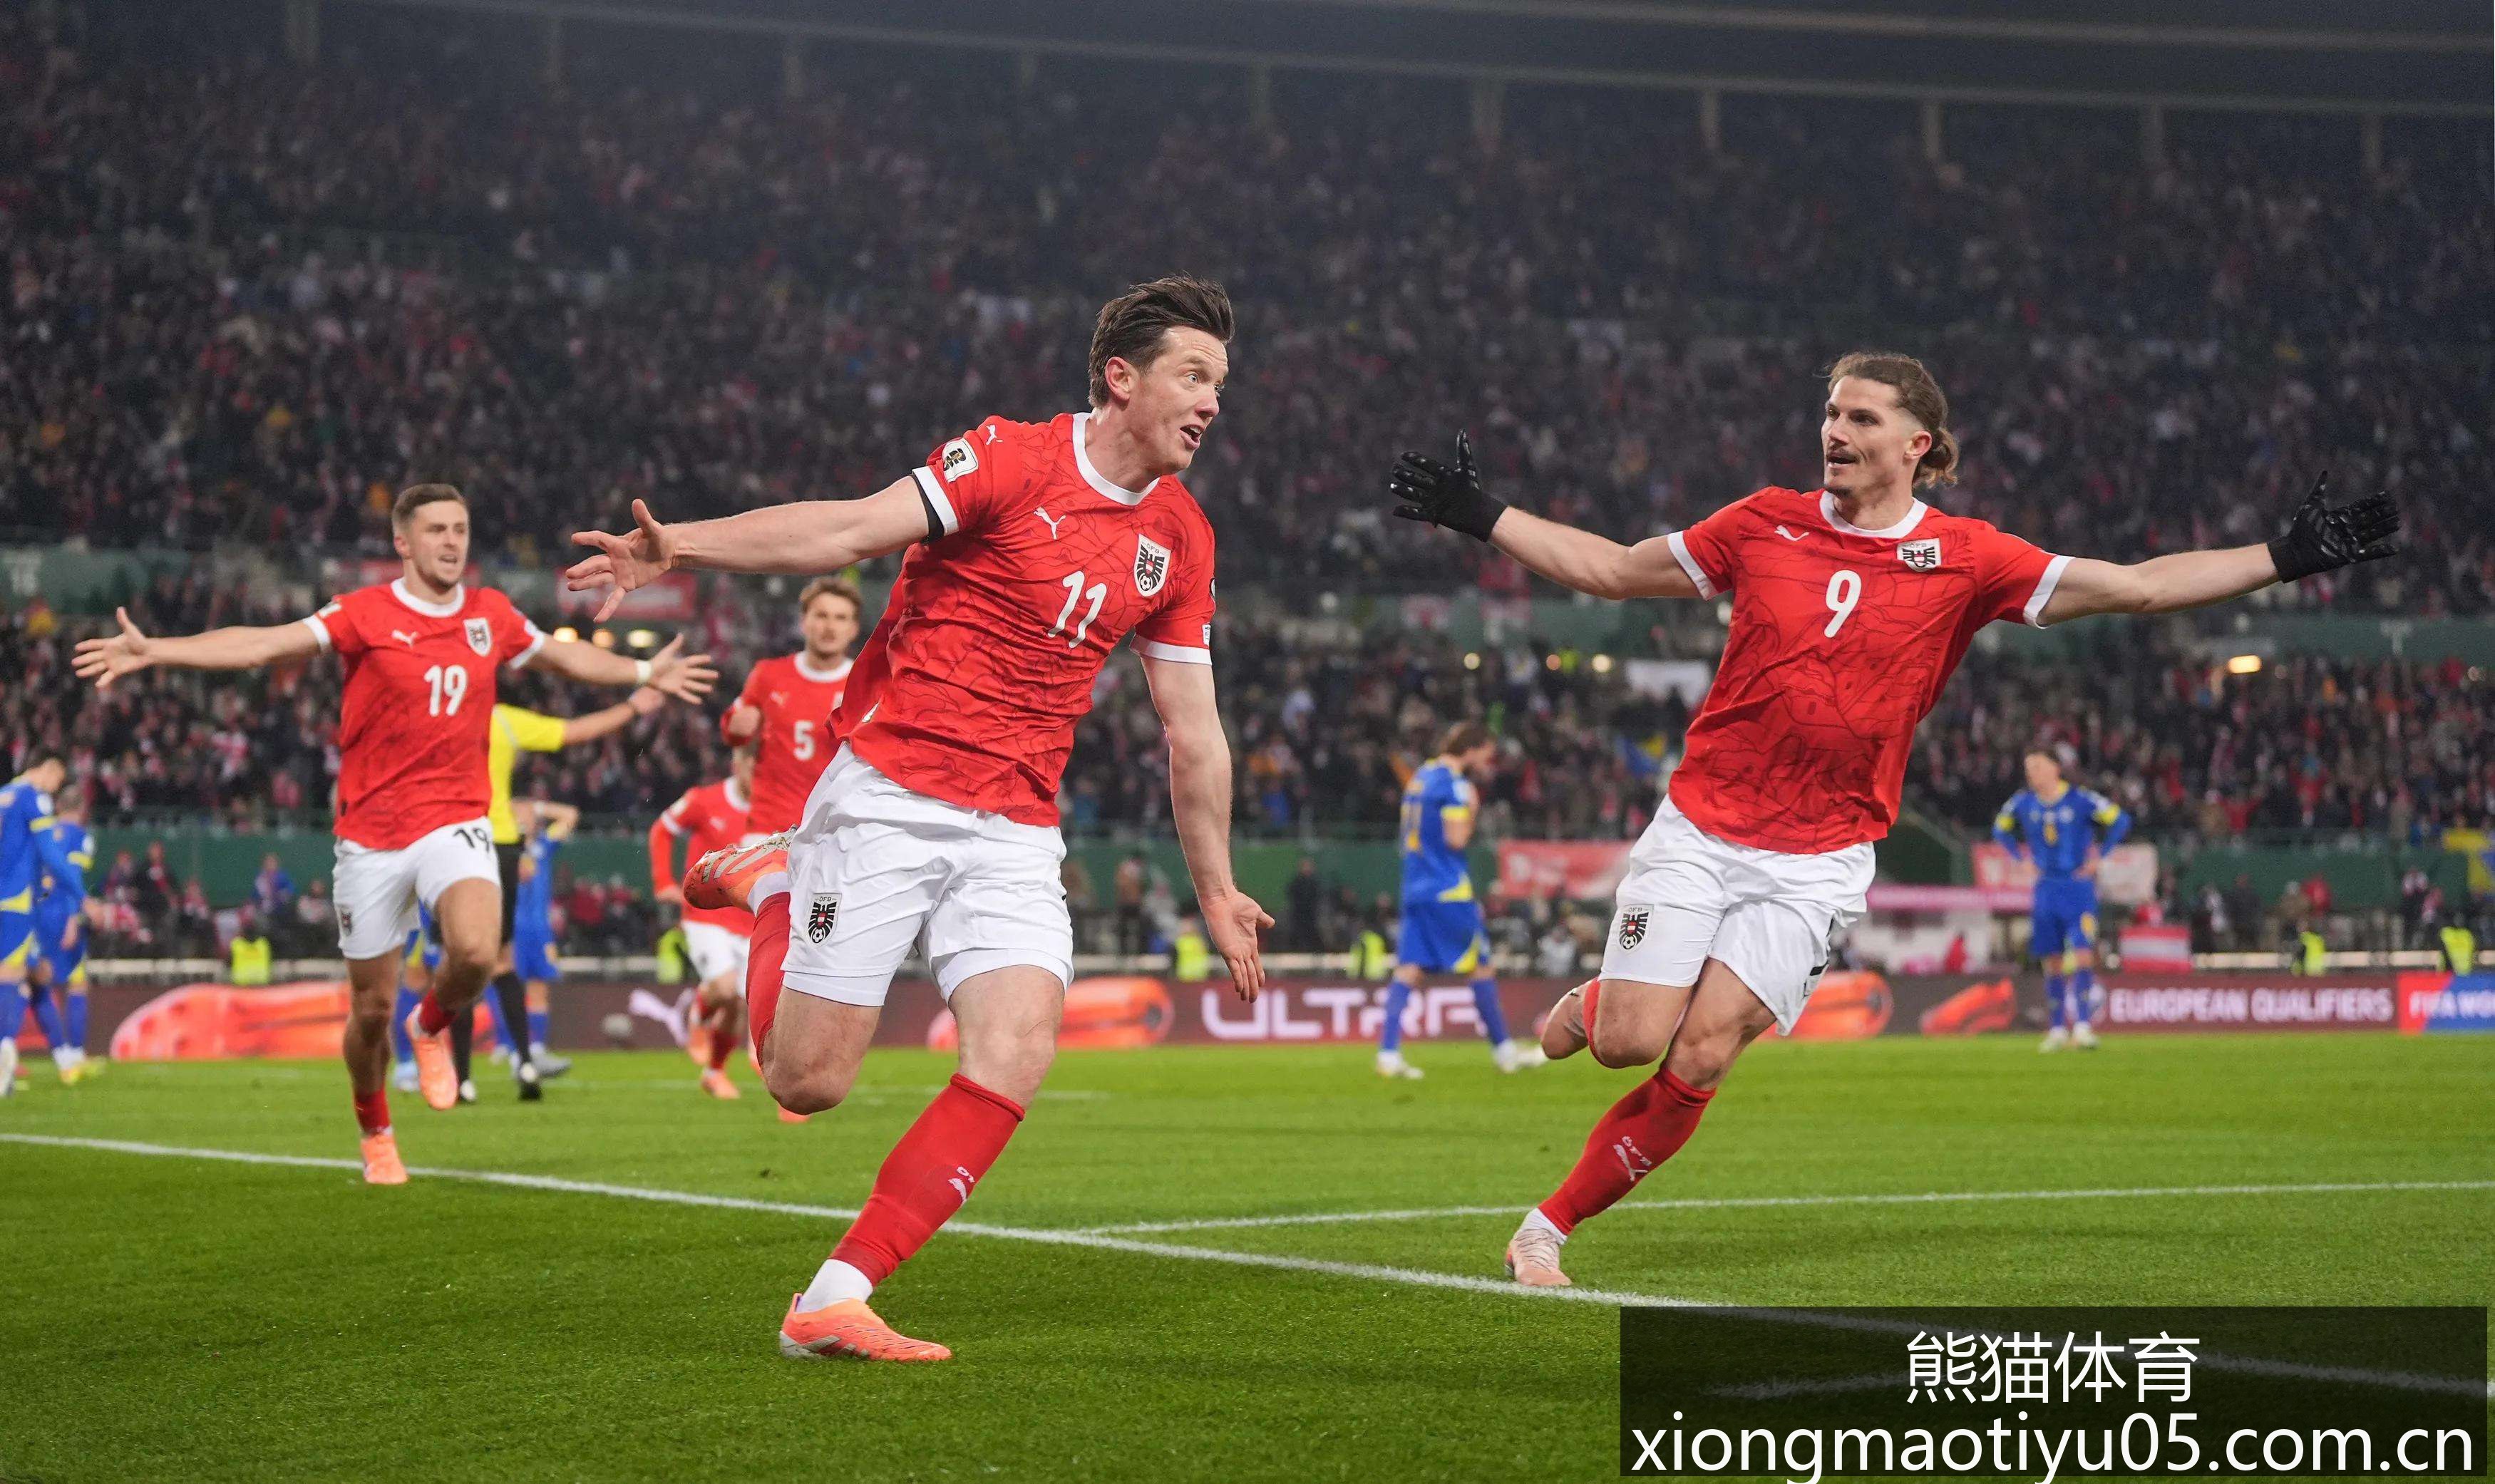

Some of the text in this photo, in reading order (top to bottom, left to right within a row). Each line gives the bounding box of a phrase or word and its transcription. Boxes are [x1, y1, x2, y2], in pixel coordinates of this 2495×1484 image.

[1048, 571, 1106, 649] 11
[1824, 570, 1861, 638] 9
[423, 664, 468, 717] 19
[793, 720, 815, 761] 5
[453, 828, 490, 853] 19
[2109, 987, 2395, 1023] EUROPEAN QUALIFIERS
